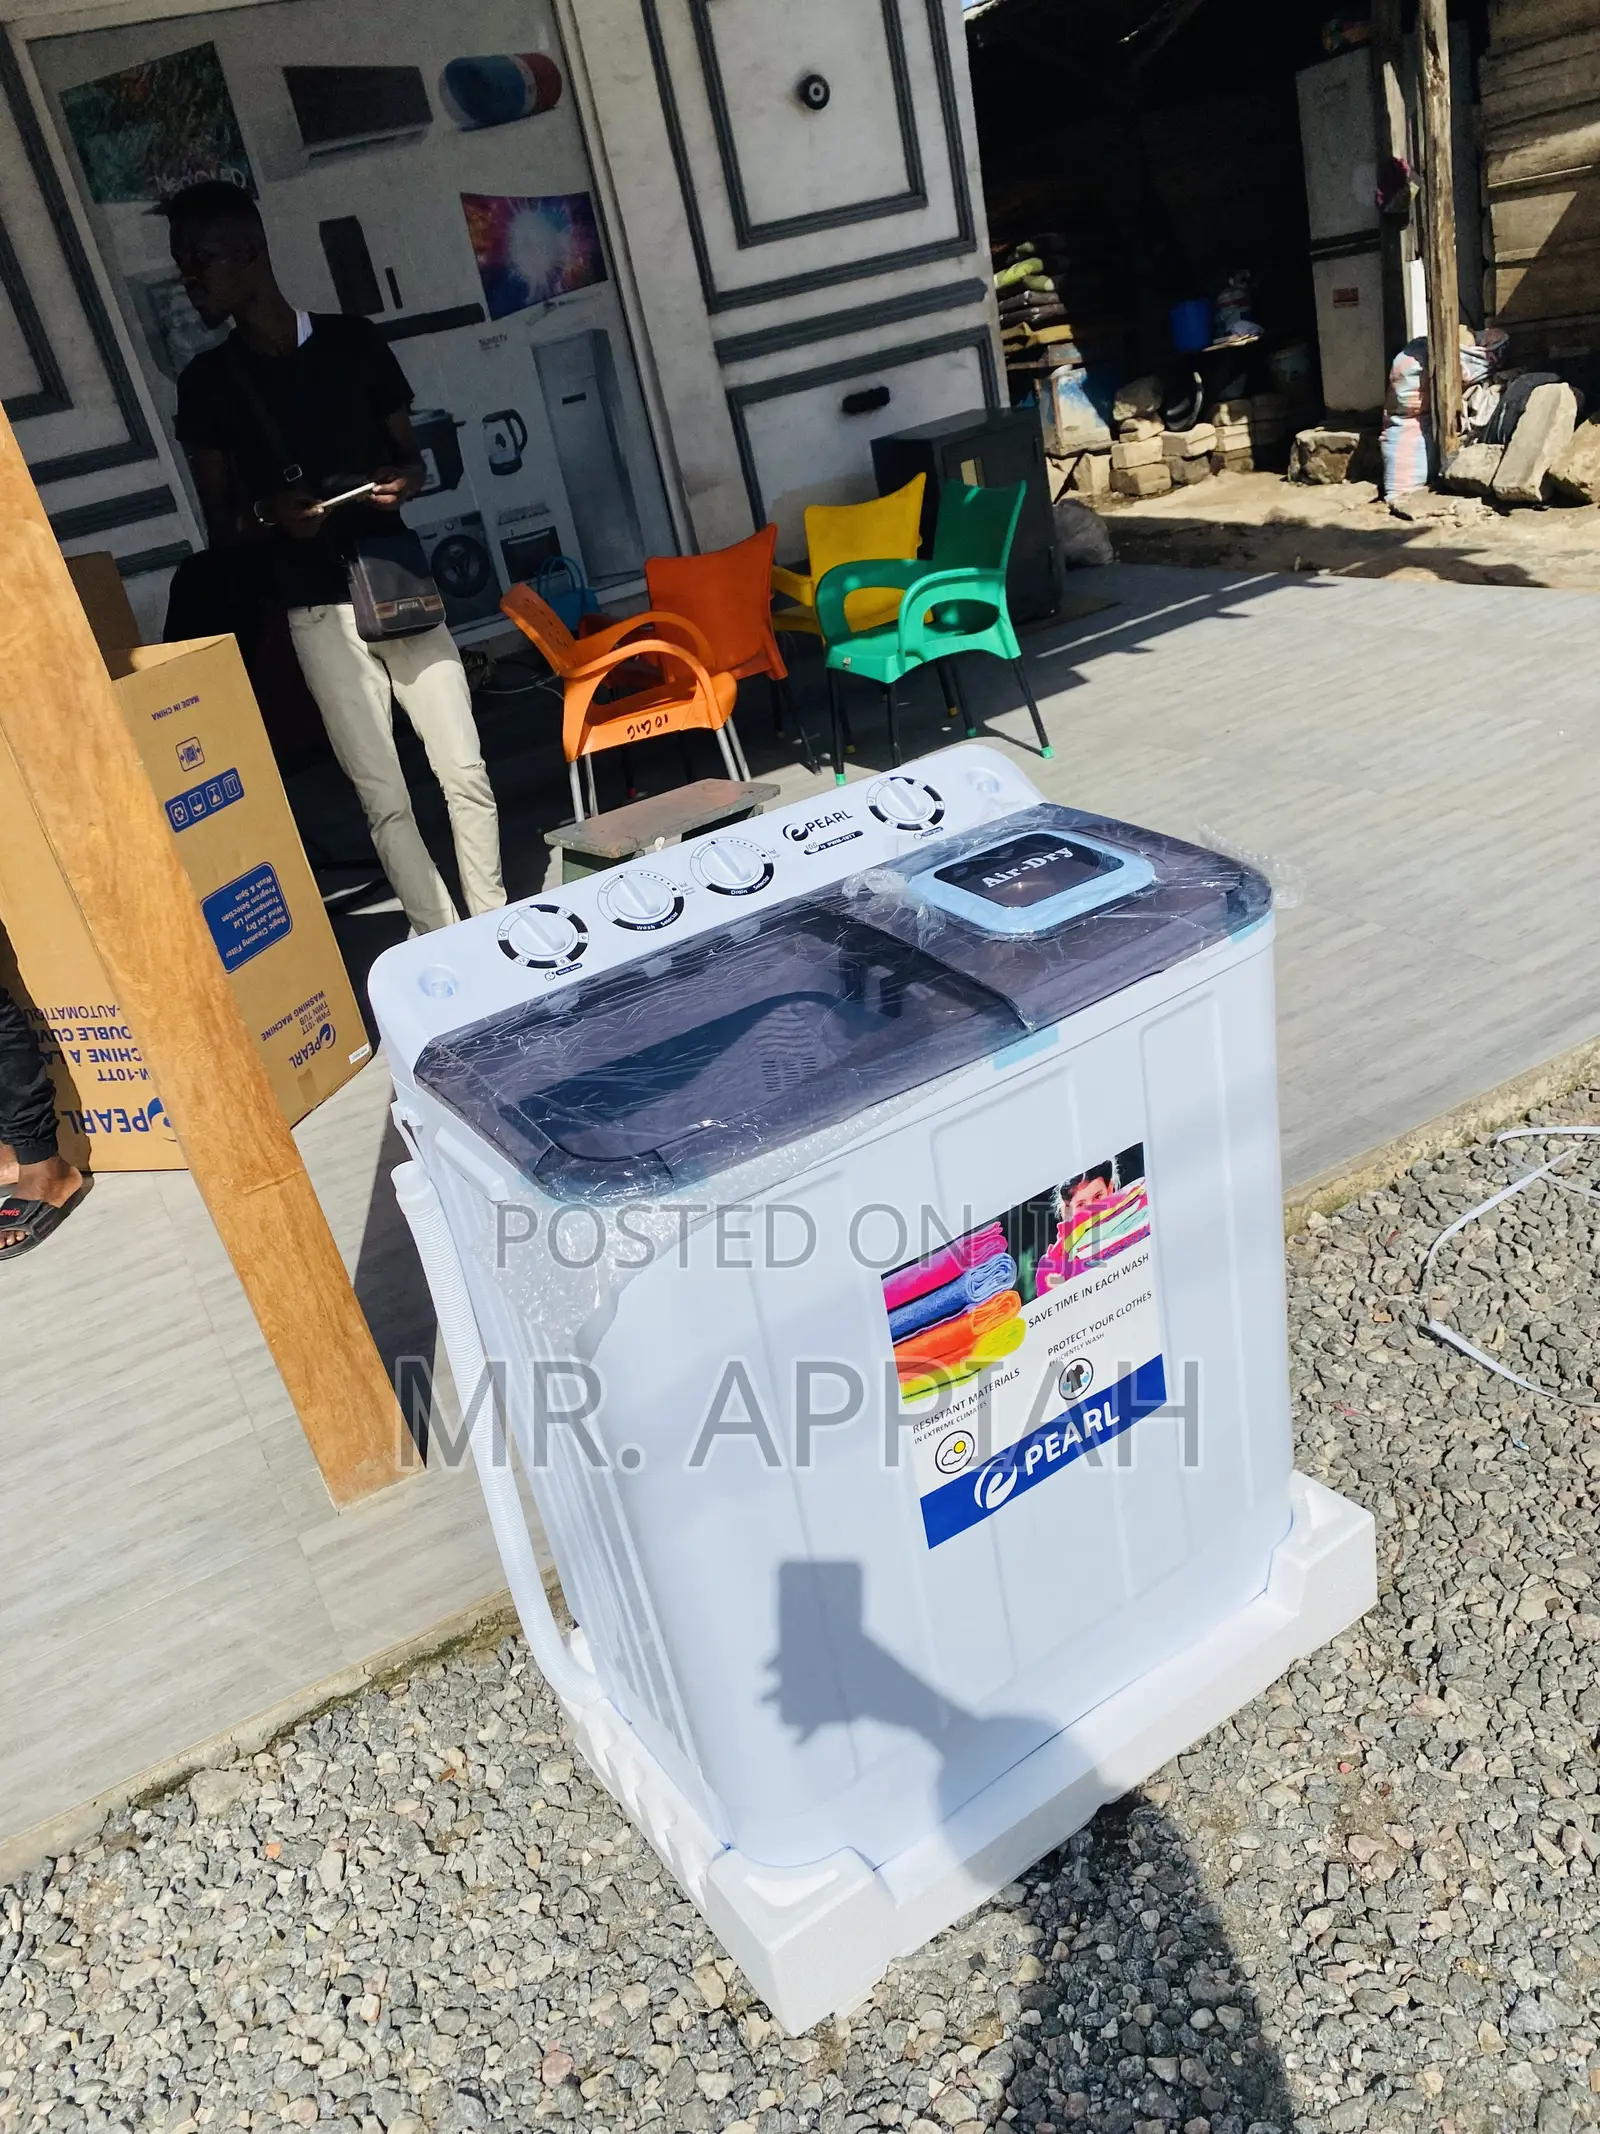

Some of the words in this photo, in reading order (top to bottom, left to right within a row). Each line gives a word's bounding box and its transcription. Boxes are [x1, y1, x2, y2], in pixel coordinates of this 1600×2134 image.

[151, 706, 173, 720] CHINA
[173, 703, 181, 712] IN
[181, 695, 200, 708] MADE
[805, 810, 853, 832] PEARL
[981, 847, 1074, 888] Air-Dry
[293, 990, 326, 1017] WASHING
[312, 1000, 329, 1018] TWIN
[261, 1014, 293, 1041] MACHINE
[300, 1012, 314, 1026] TUB
[301, 1008, 331, 1036] PWM-10TT
[288, 1036, 321, 1068] PEARL
[60, 1107, 149, 1135] PEARL
[1028, 1307, 1052, 1328] SAVE
[1055, 1292, 1079, 1312] TIME
[1081, 1285, 1093, 1298] IN
[1095, 1271, 1120, 1292] EACH
[1121, 1253, 1149, 1275] WASH
[1047, 1327, 1087, 1356] PROTECT
[1089, 1314, 1114, 1333] YOUR
[1116, 1290, 1152, 1318] CLOTHES
[1085, 1332, 1105, 1346] WASH
[912, 1399, 966, 1434] RESISTANT
[968, 1367, 1020, 1405] MATERIALS
[914, 1436, 922, 1445] IN
[924, 1419, 955, 1440] EXTREME
[956, 1400, 988, 1423] CLIMATES
[1024, 1400, 1121, 1477] PEARL
